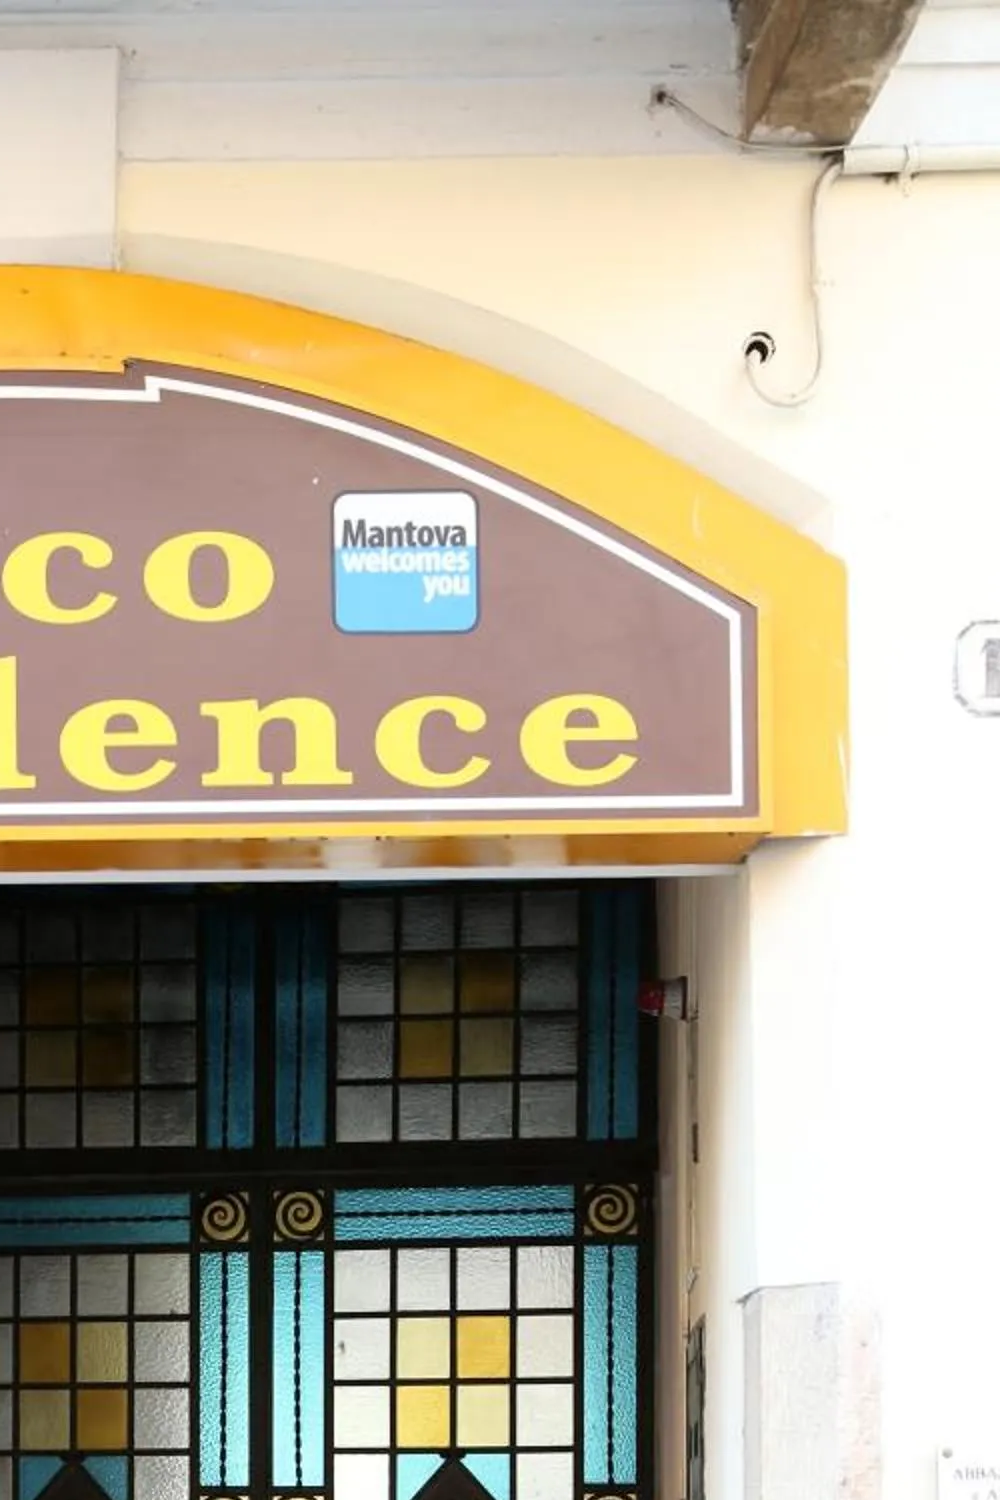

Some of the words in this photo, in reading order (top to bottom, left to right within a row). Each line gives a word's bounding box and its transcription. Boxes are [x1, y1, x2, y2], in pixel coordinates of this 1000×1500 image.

[342, 518, 467, 548] Mantova
[341, 547, 470, 574] welcomes
[422, 573, 470, 604] you
